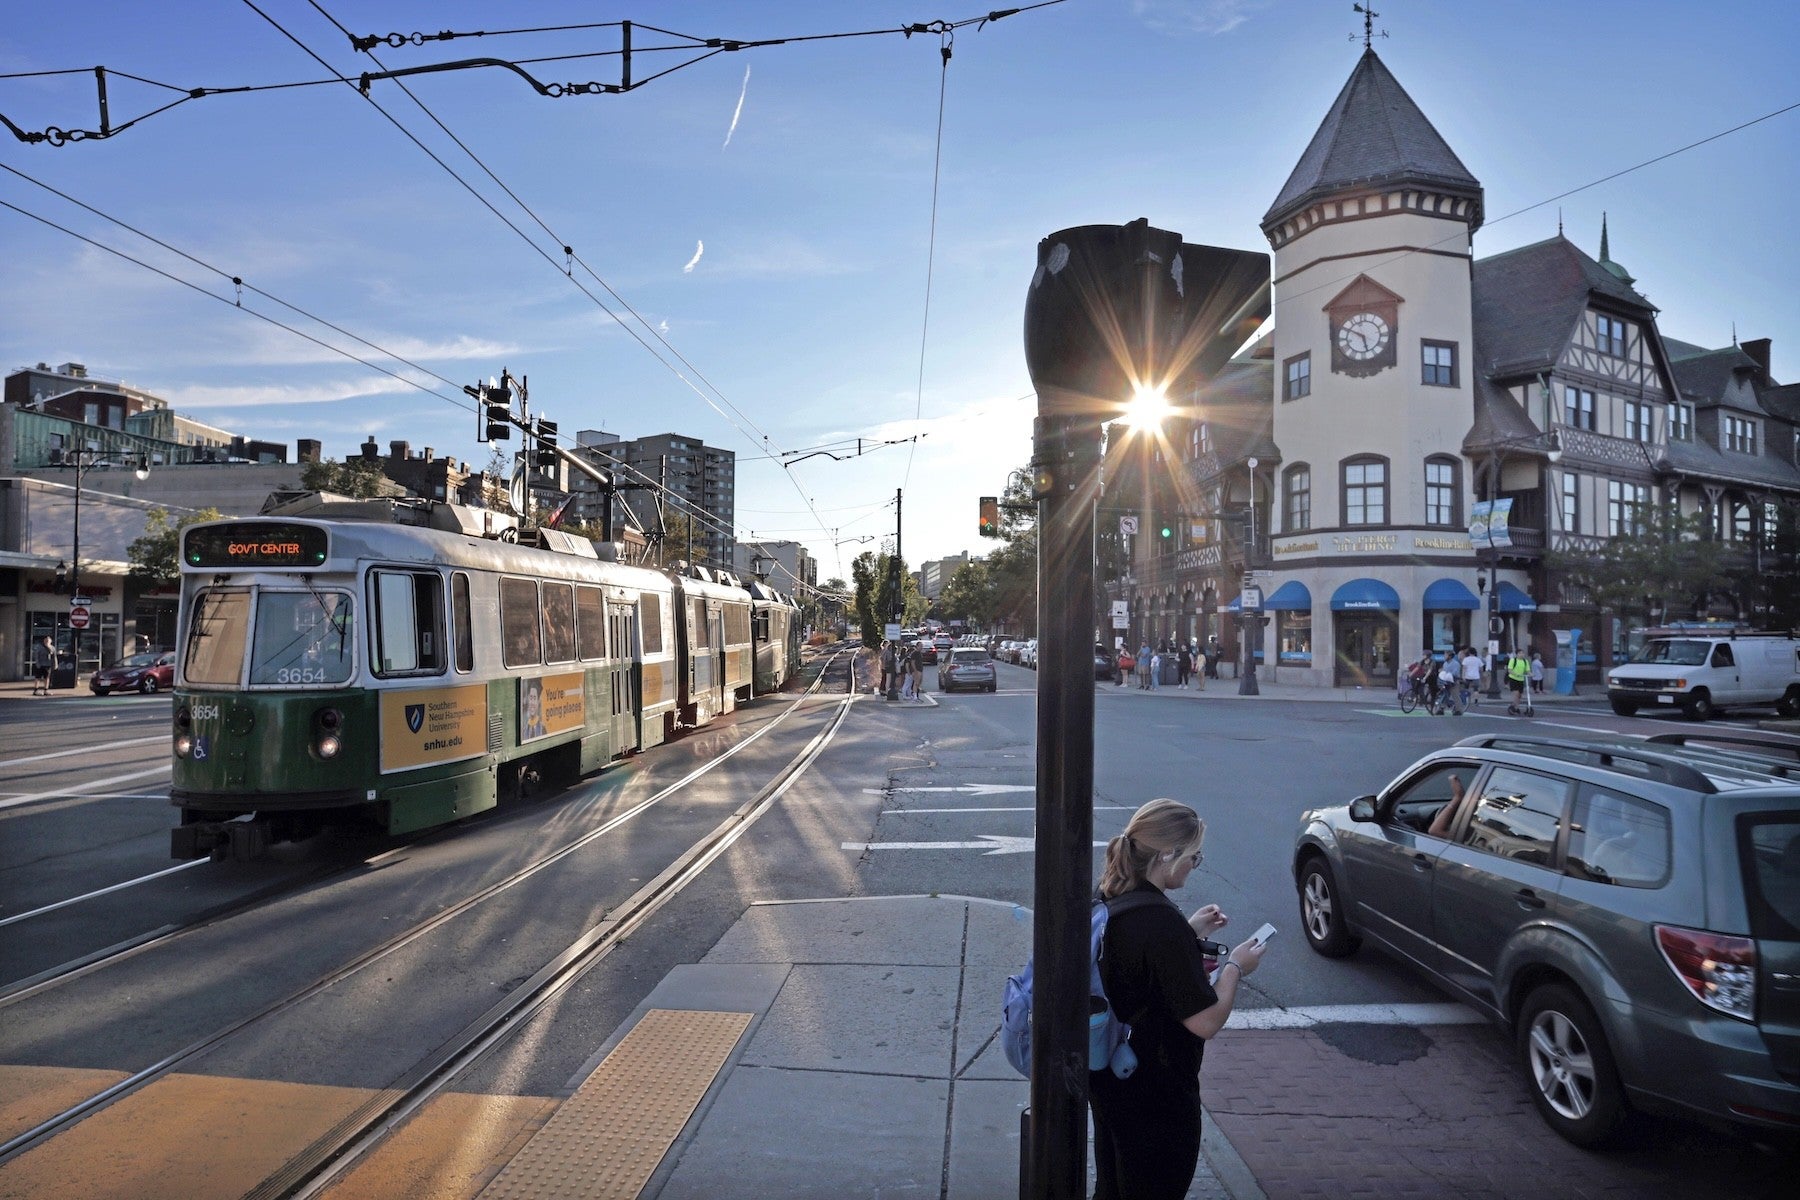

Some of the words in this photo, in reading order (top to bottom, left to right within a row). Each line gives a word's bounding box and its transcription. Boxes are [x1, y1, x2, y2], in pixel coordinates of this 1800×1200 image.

[260, 543, 300, 554] CENTER
[277, 668, 327, 683] 3654
[545, 687, 565, 701] You're
[191, 705, 219, 720] 3654
[428, 701, 458, 711] Southern
[545, 704, 563, 722] going
[563, 702, 582, 719] places
[429, 712, 445, 721] New
[445, 708, 475, 720] Hampshire
[429, 721, 461, 733] University
[424, 736, 463, 751] snhu.edu
